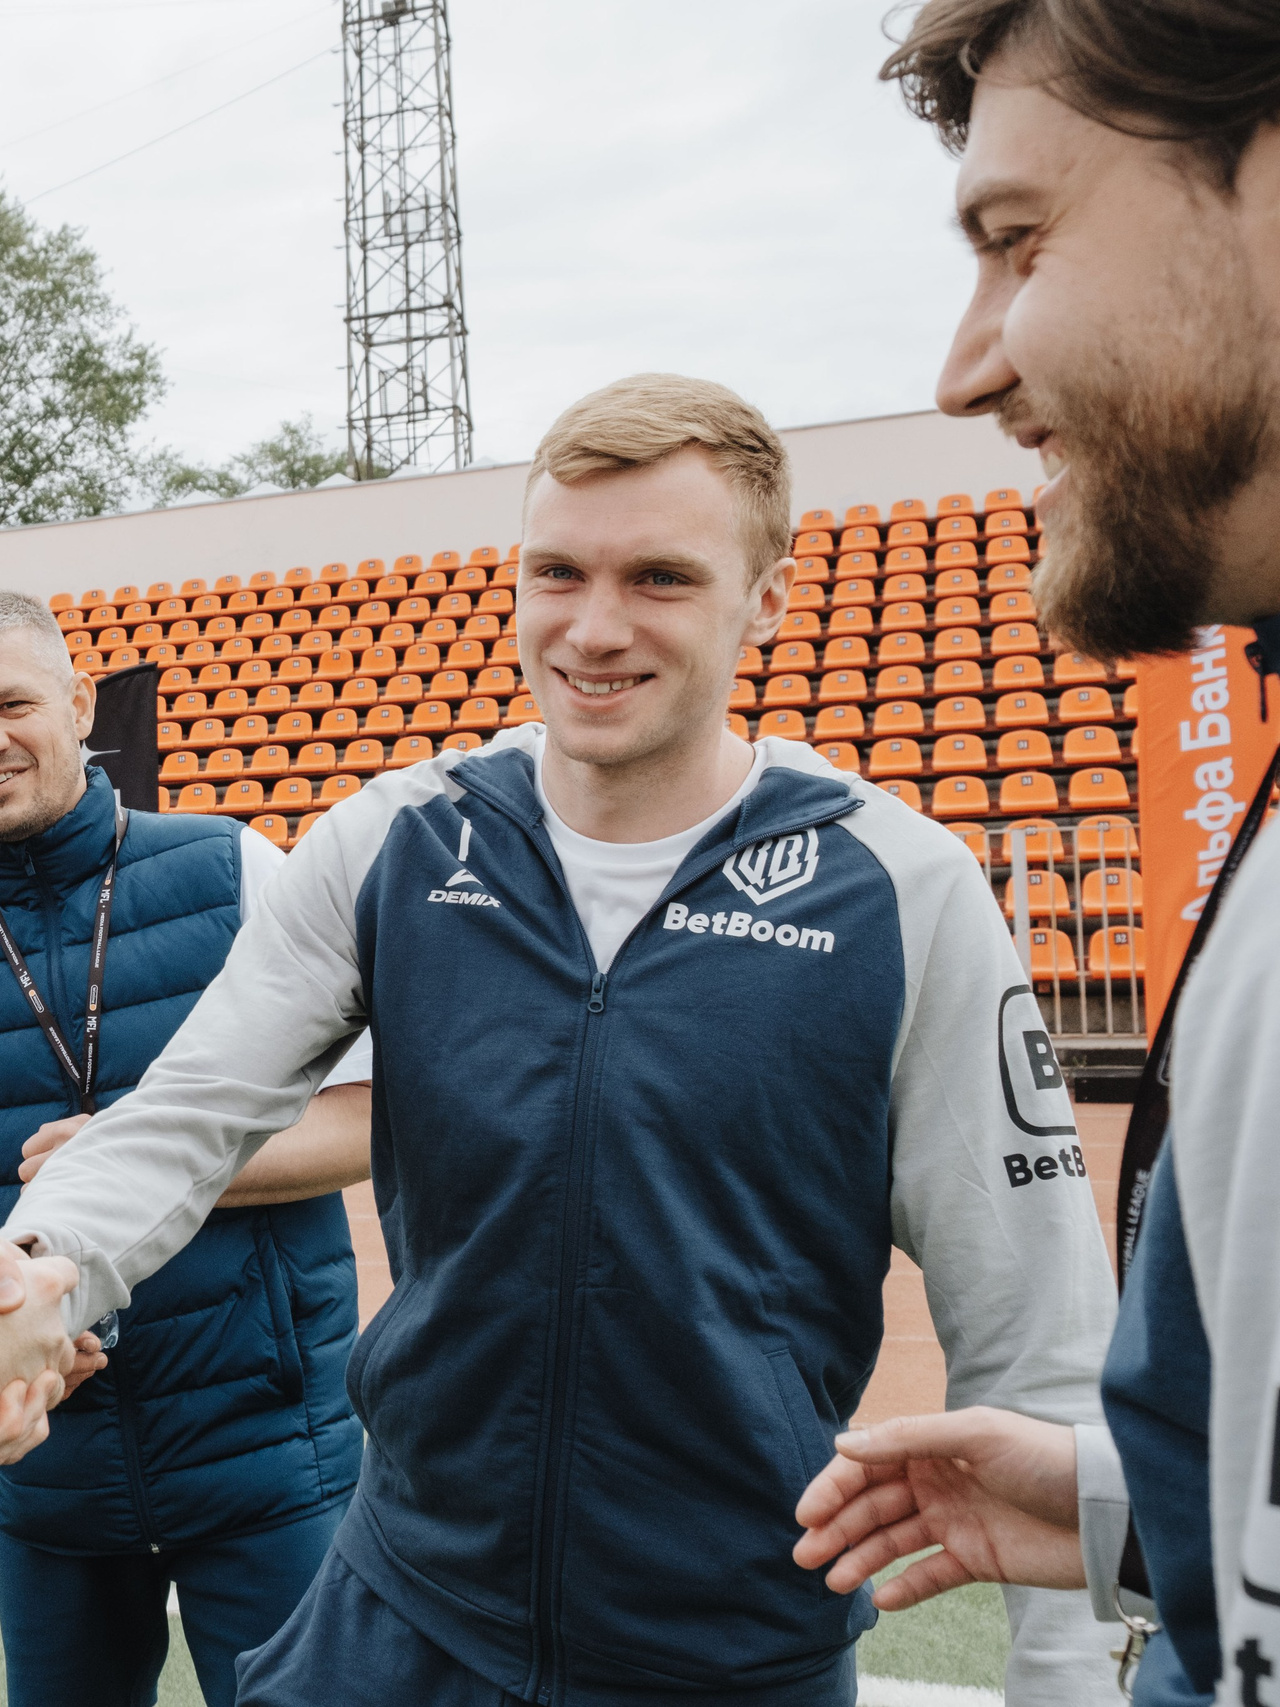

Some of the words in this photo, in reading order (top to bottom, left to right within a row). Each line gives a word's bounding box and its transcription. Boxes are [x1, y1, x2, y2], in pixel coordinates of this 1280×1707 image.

[1016, 699, 1026, 707] 31
[1085, 730, 1095, 739] 32
[1018, 740, 1028, 749] 31
[1022, 776, 1032, 785] 31
[1093, 773, 1103, 783] 32
[1031, 874, 1041, 883] 31
[1107, 875, 1118, 884] 32
[428, 889, 501, 908] DEMIX
[663, 902, 835, 953] BetBoom
[1035, 933, 1046, 943] 31
[1116, 934, 1126, 943] 32
[86, 1016, 97, 1032] MFL
